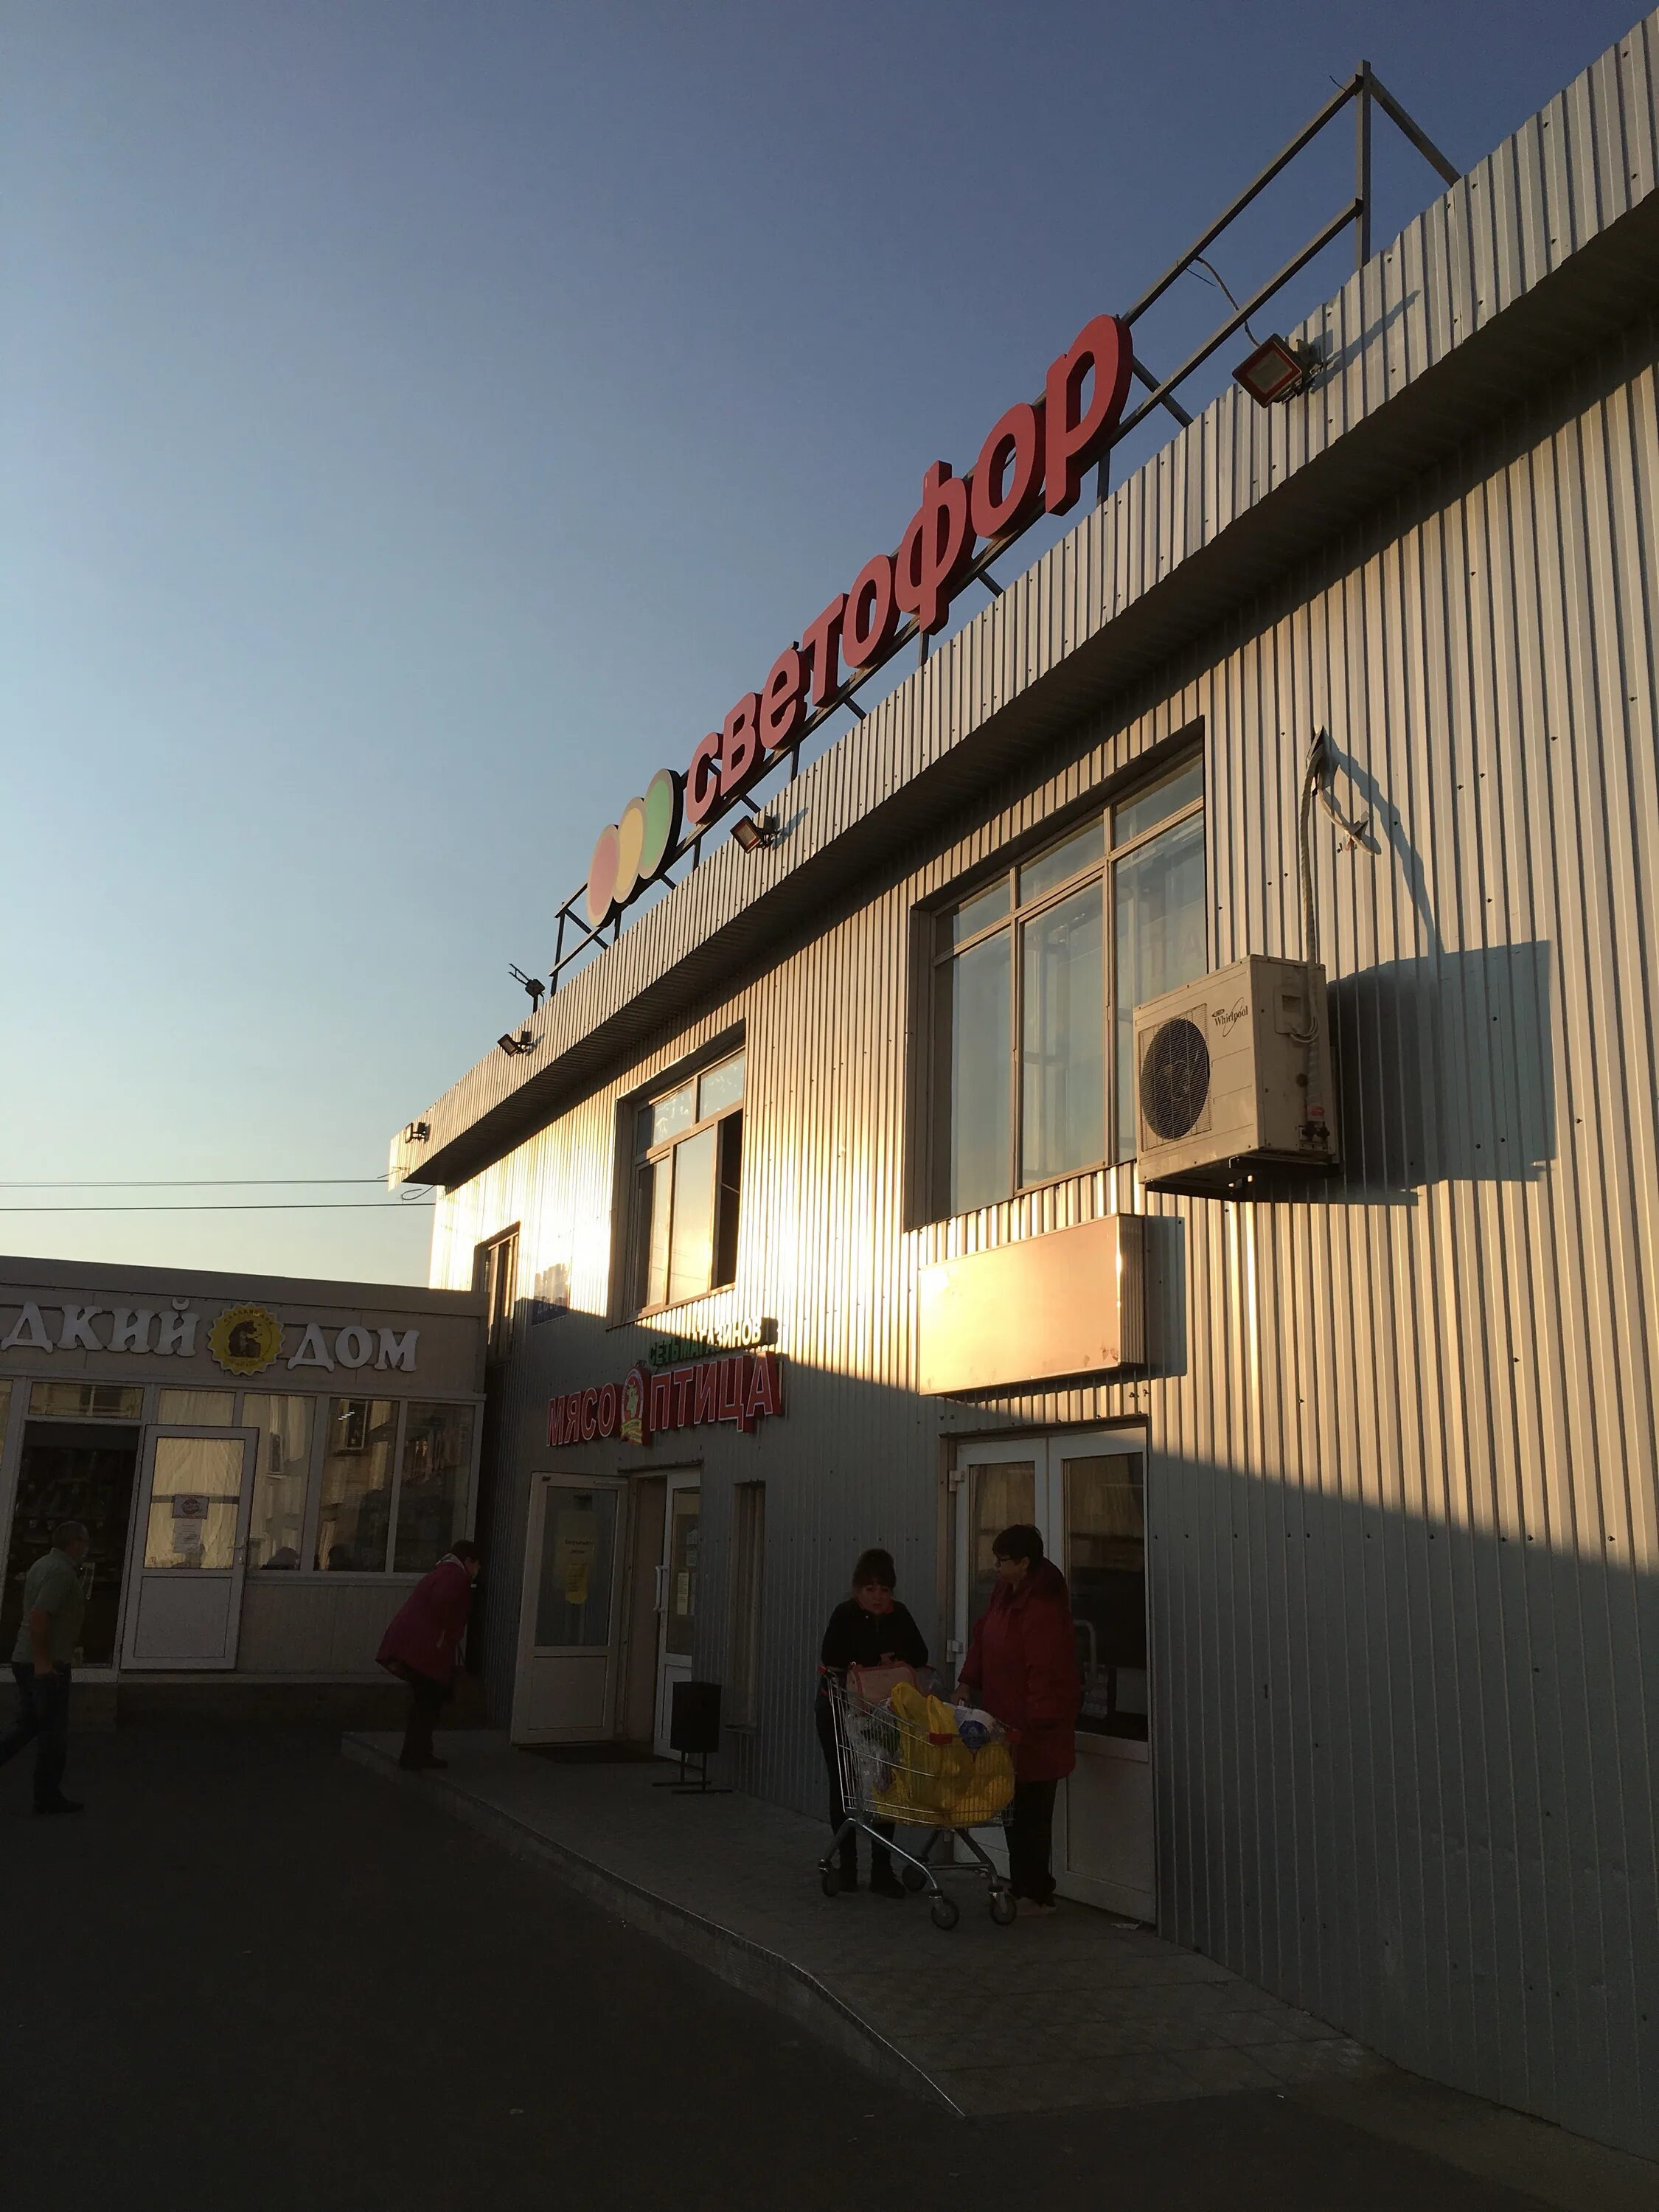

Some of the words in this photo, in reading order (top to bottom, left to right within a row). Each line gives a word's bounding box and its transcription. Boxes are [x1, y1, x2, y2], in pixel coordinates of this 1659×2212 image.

[685, 314, 1133, 825] светофор
[1214, 1006, 1248, 1026] Whirlpool
[1, 1298, 200, 1357] ДКИЙ
[288, 1323, 419, 1372] ДОМ
[546, 1382, 616, 1447] МЯСО
[650, 1350, 773, 1433] ПТИЦА
